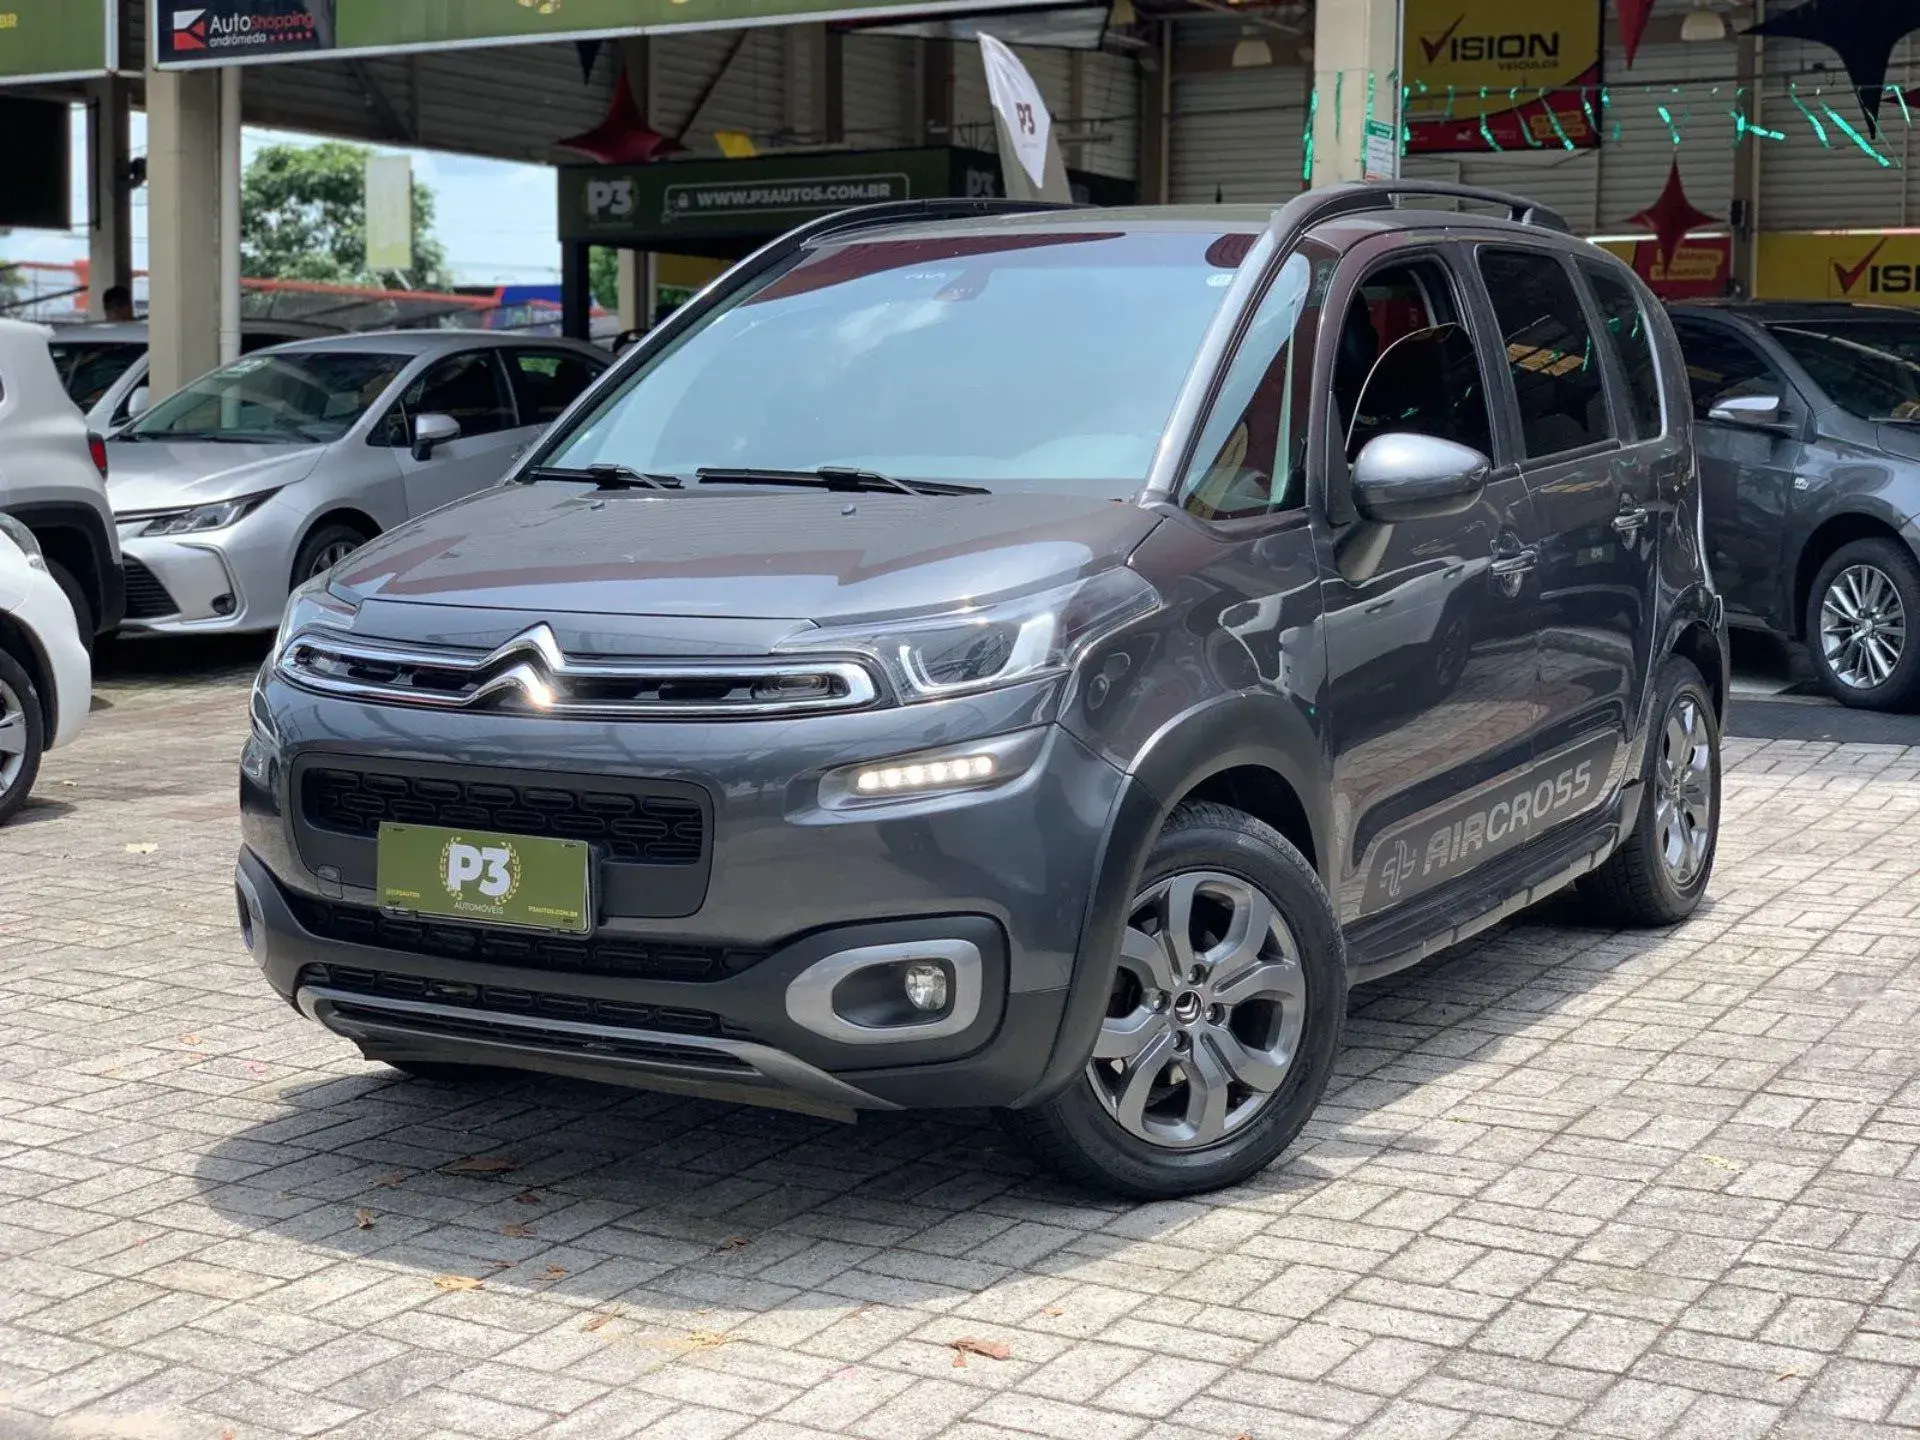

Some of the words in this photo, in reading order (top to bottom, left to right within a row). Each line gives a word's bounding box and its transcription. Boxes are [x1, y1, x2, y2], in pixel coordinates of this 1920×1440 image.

[1420, 12, 1560, 65] VISION
[1016, 102, 1036, 135] P3
[586, 180, 634, 215] P3
[696, 183, 891, 208] WWW.P3AUTOS.COM.BR
[1422, 759, 1592, 877] AIRCROSS
[446, 843, 511, 897] P3
